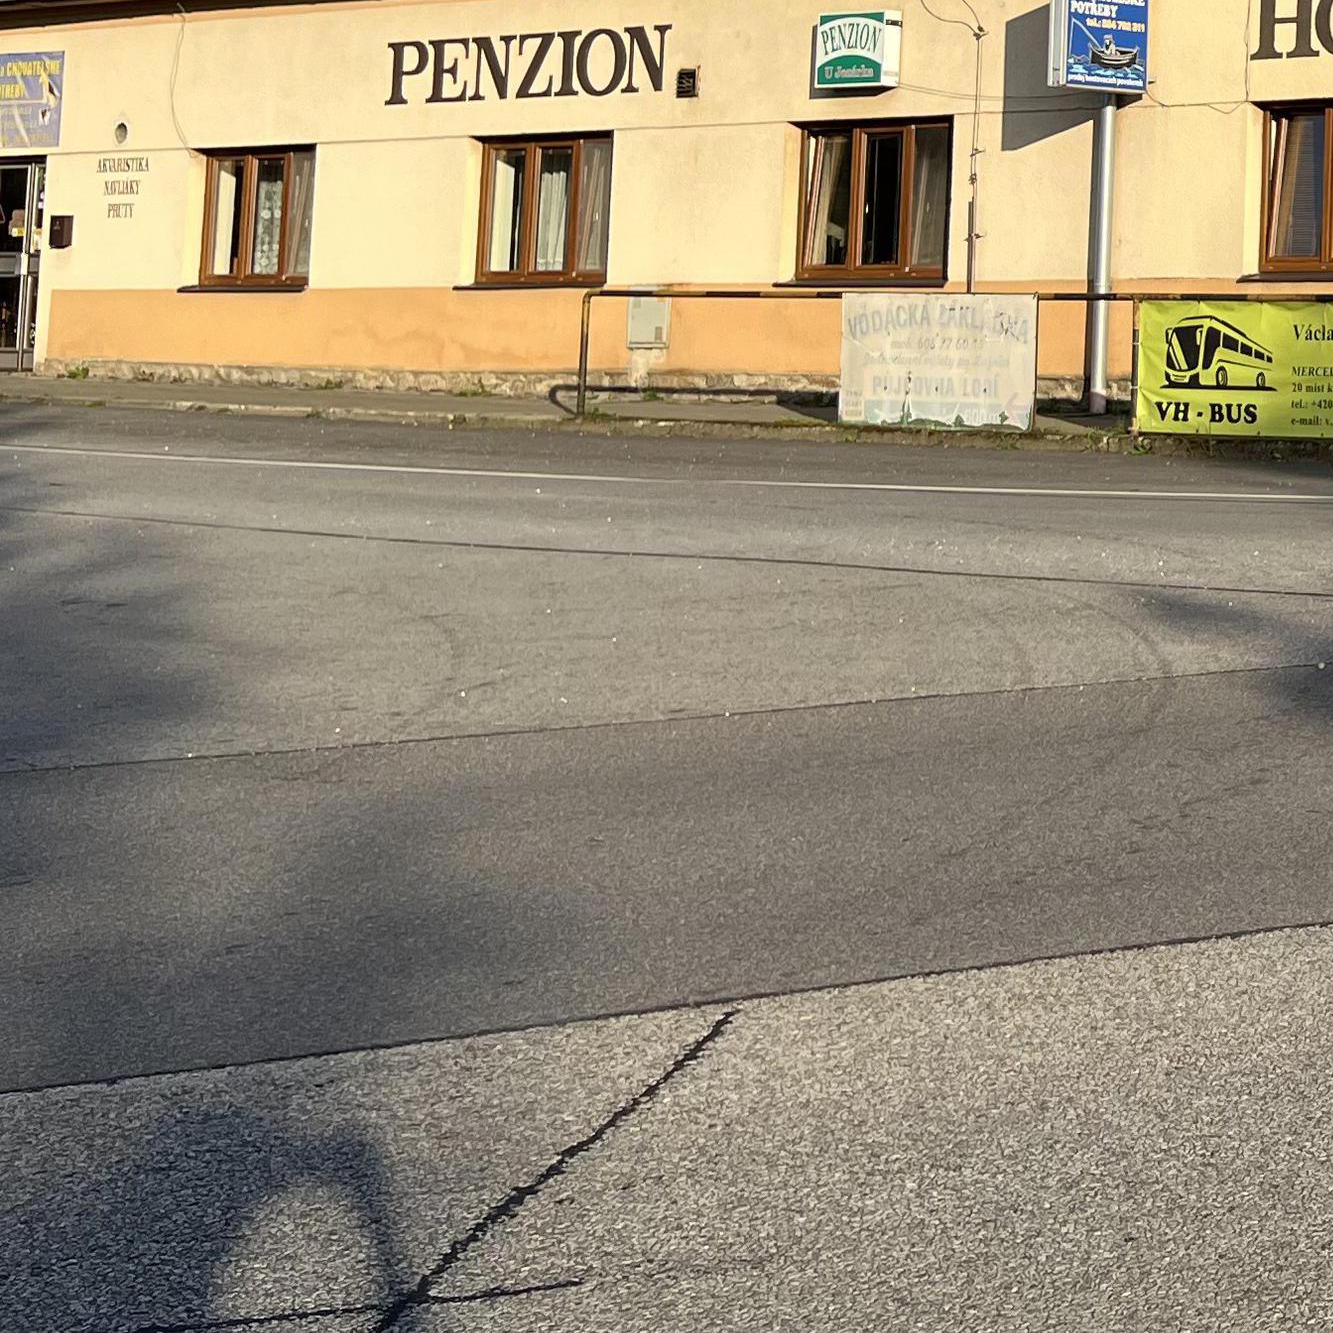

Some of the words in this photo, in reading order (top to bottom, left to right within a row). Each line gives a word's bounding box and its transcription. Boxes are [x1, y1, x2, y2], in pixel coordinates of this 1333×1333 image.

[1071, 0, 1118, 18] POTŘEBY
[821, 22, 882, 55] PENZION
[385, 24, 673, 106] PENZION
[824, 66, 834, 79] U
[96, 157, 150, 173] AKVARISTIKA
[107, 203, 135, 218] PRUTY
[848, 298, 930, 340] VODÁCKÁ
[1292, 383, 1303, 393] 20
[1305, 383, 1324, 394] míst
[1327, 383, 1332, 394] k
[1155, 402, 1188, 423] VH
[1210, 403, 1258, 424] BUS
[1291, 400, 1308, 410] tel.:
[1311, 400, 1333, 410] +420
[1291, 417, 1322, 427] e-mail:
